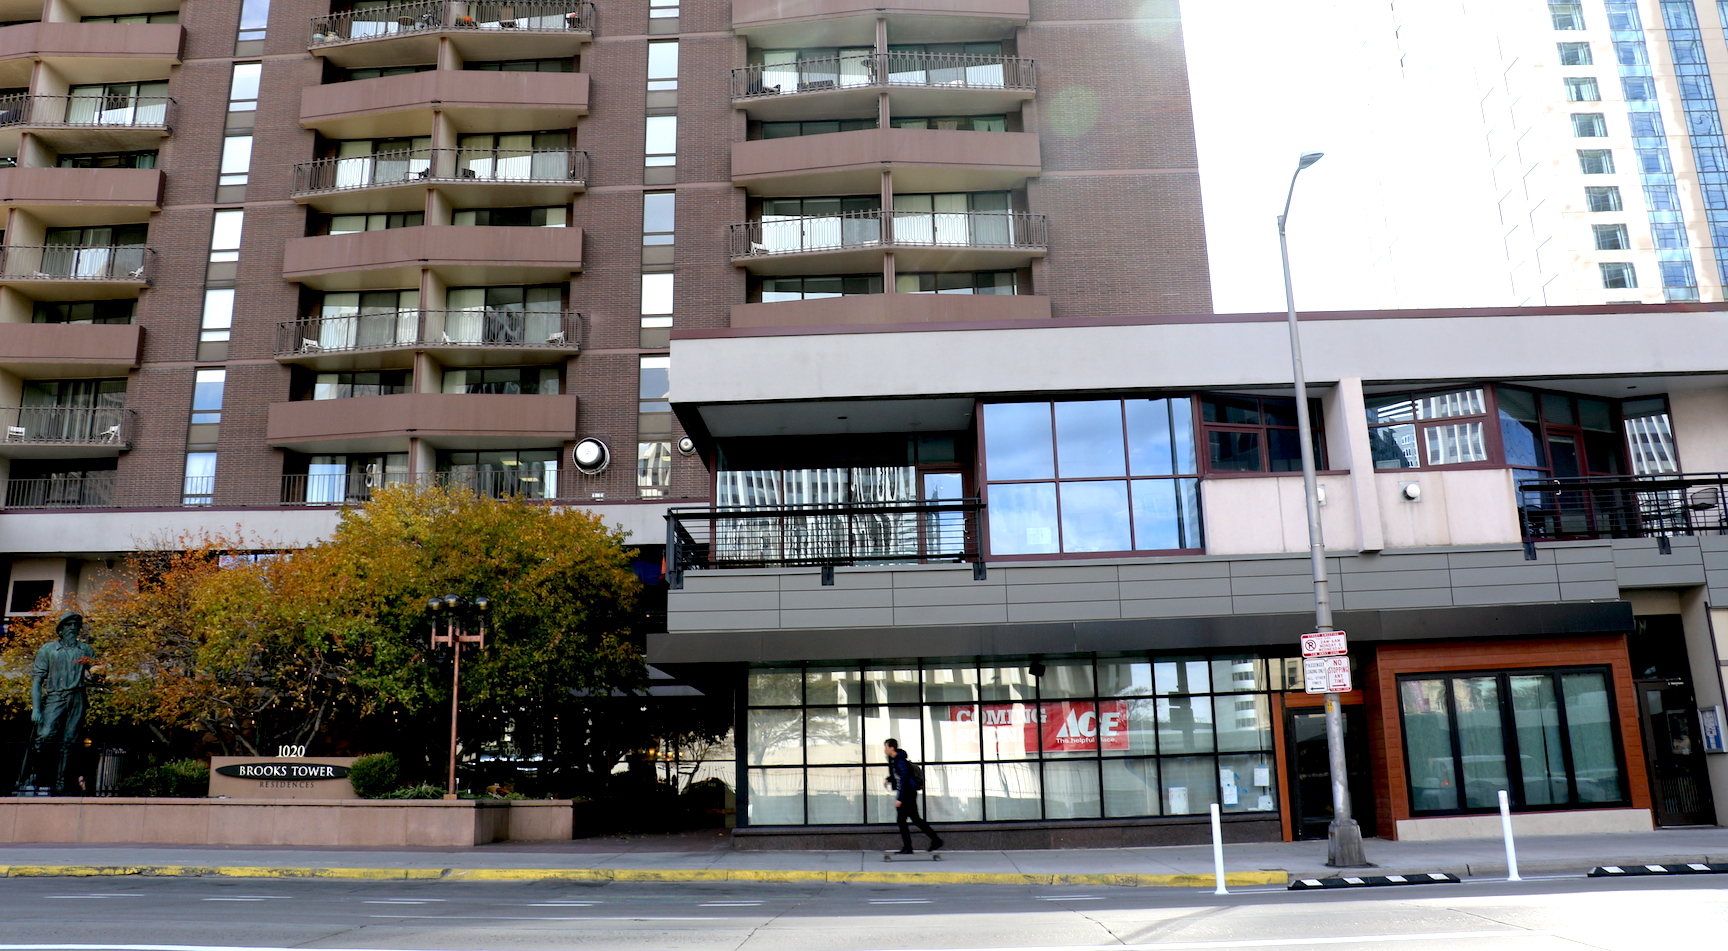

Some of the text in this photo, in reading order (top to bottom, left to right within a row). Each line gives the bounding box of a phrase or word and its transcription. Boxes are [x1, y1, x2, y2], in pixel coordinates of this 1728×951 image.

[1328, 666, 1349, 674] STOPPING
[956, 708, 1048, 725] COMING
[1056, 708, 1120, 738] ACE
[276, 745, 305, 758] 1020
[239, 765, 335, 777] BROOKS TOWER
[259, 781, 315, 789] RESIDENCES
